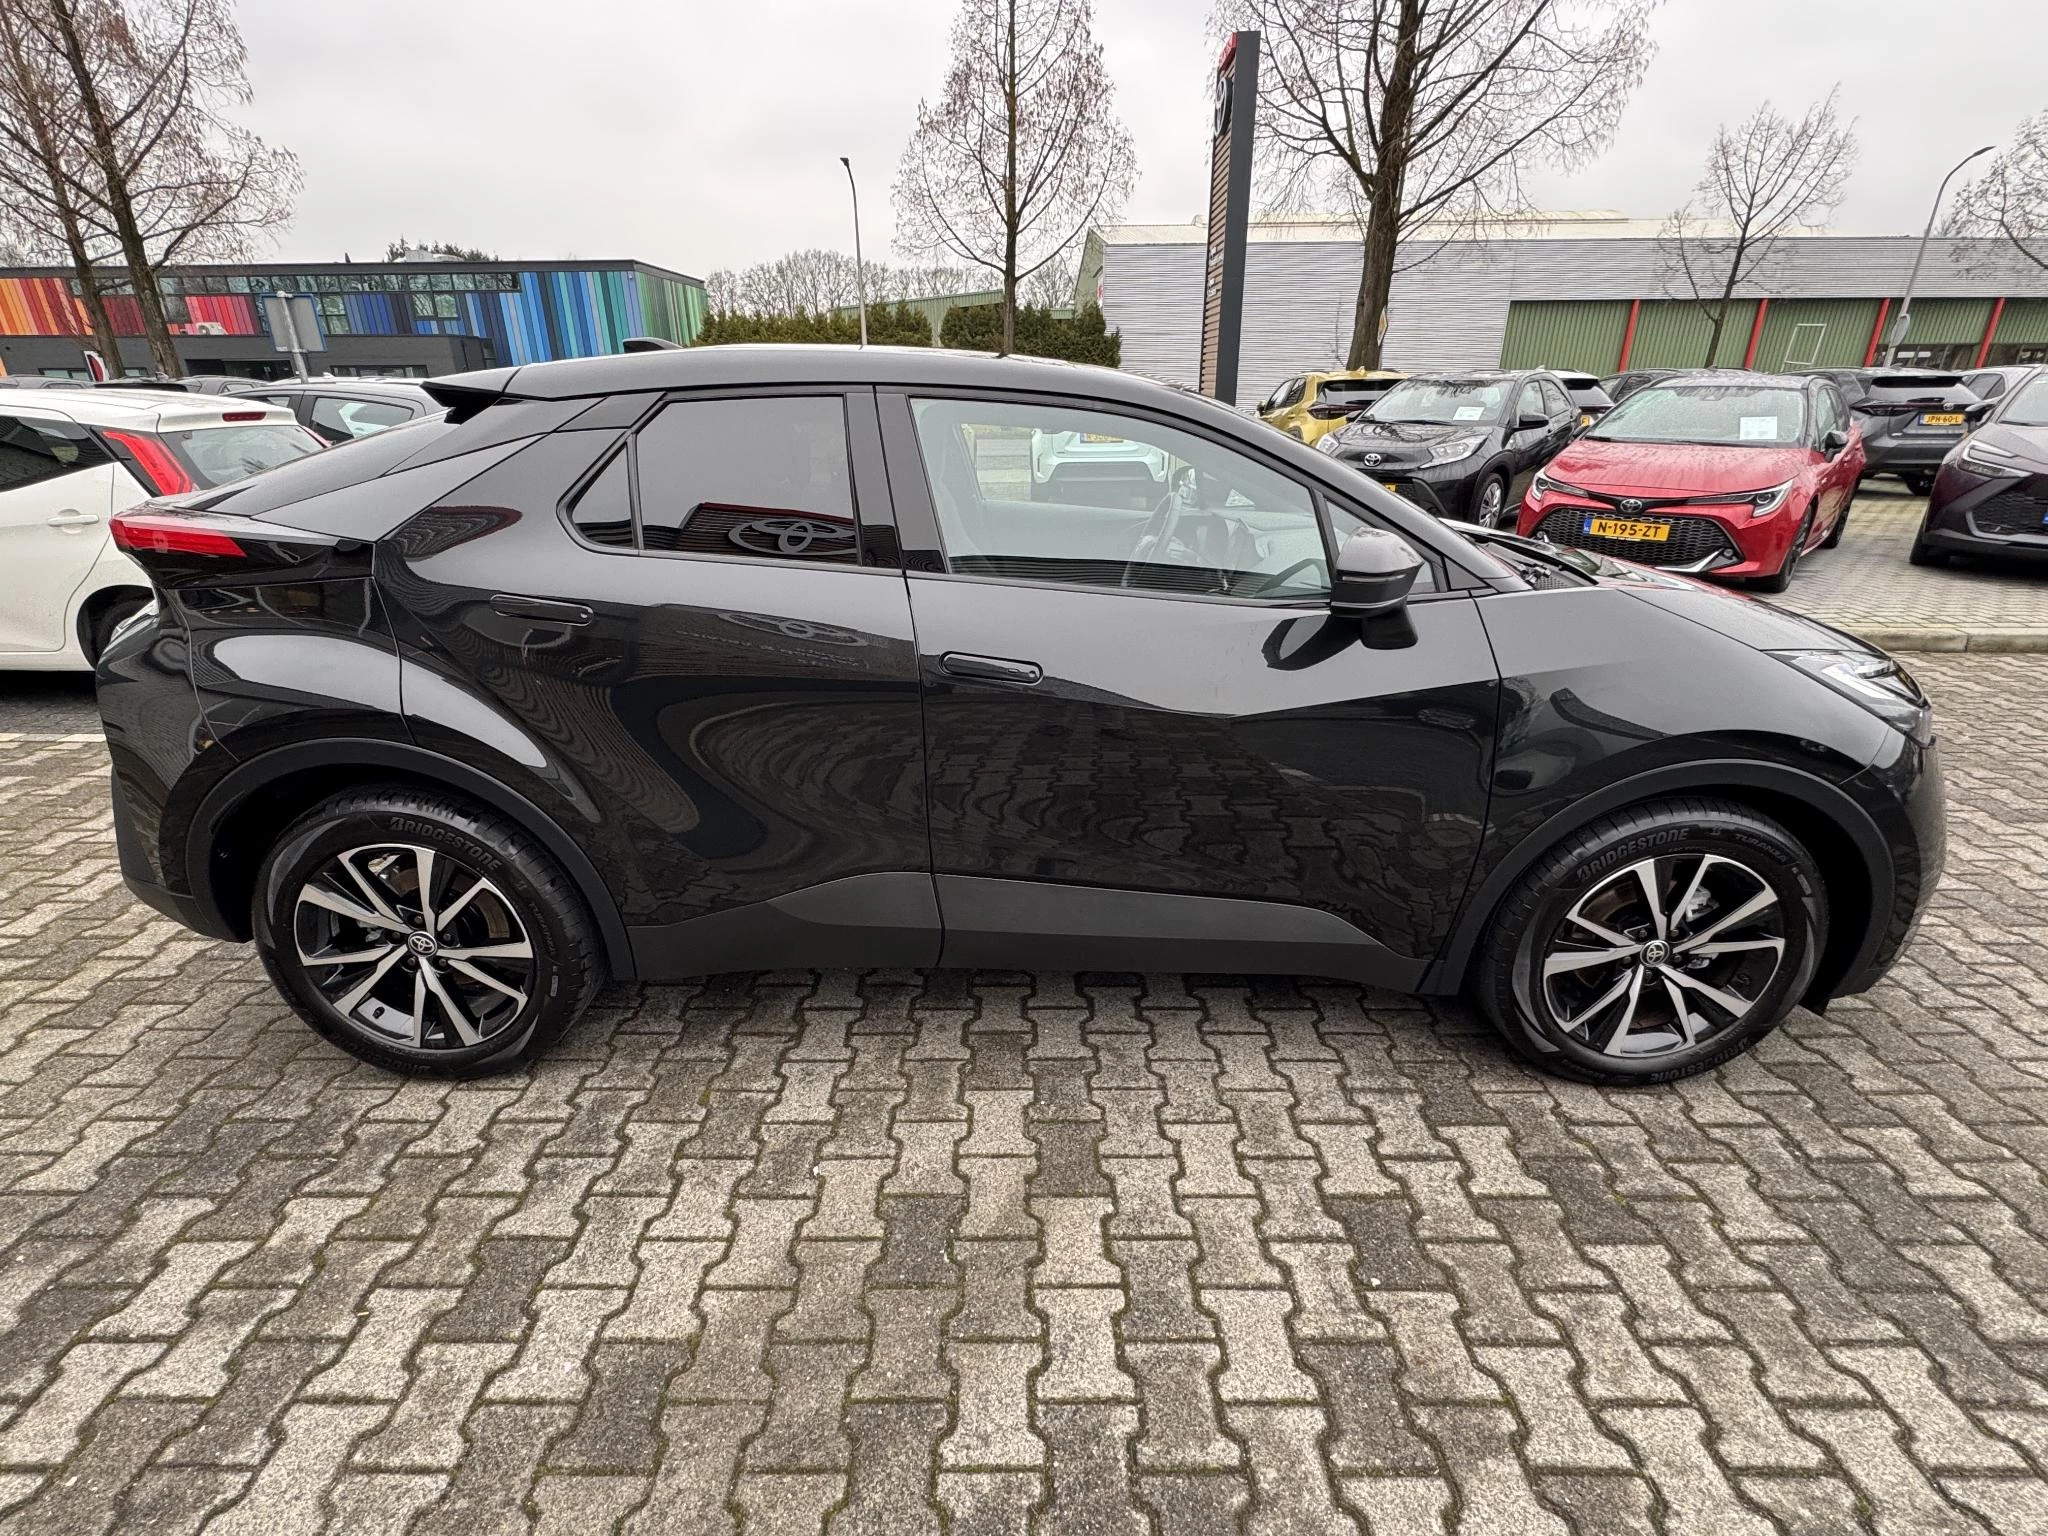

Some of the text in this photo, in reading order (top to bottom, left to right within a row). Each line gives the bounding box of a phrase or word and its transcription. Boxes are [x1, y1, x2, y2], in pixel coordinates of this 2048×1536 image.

[1926, 415, 1960, 423] JPH-60-L
[1597, 521, 1661, 538] N-195-ZT
[389, 816, 503, 872] BRIDGESTONE
[1576, 827, 1690, 883] BRIDGESTONE
